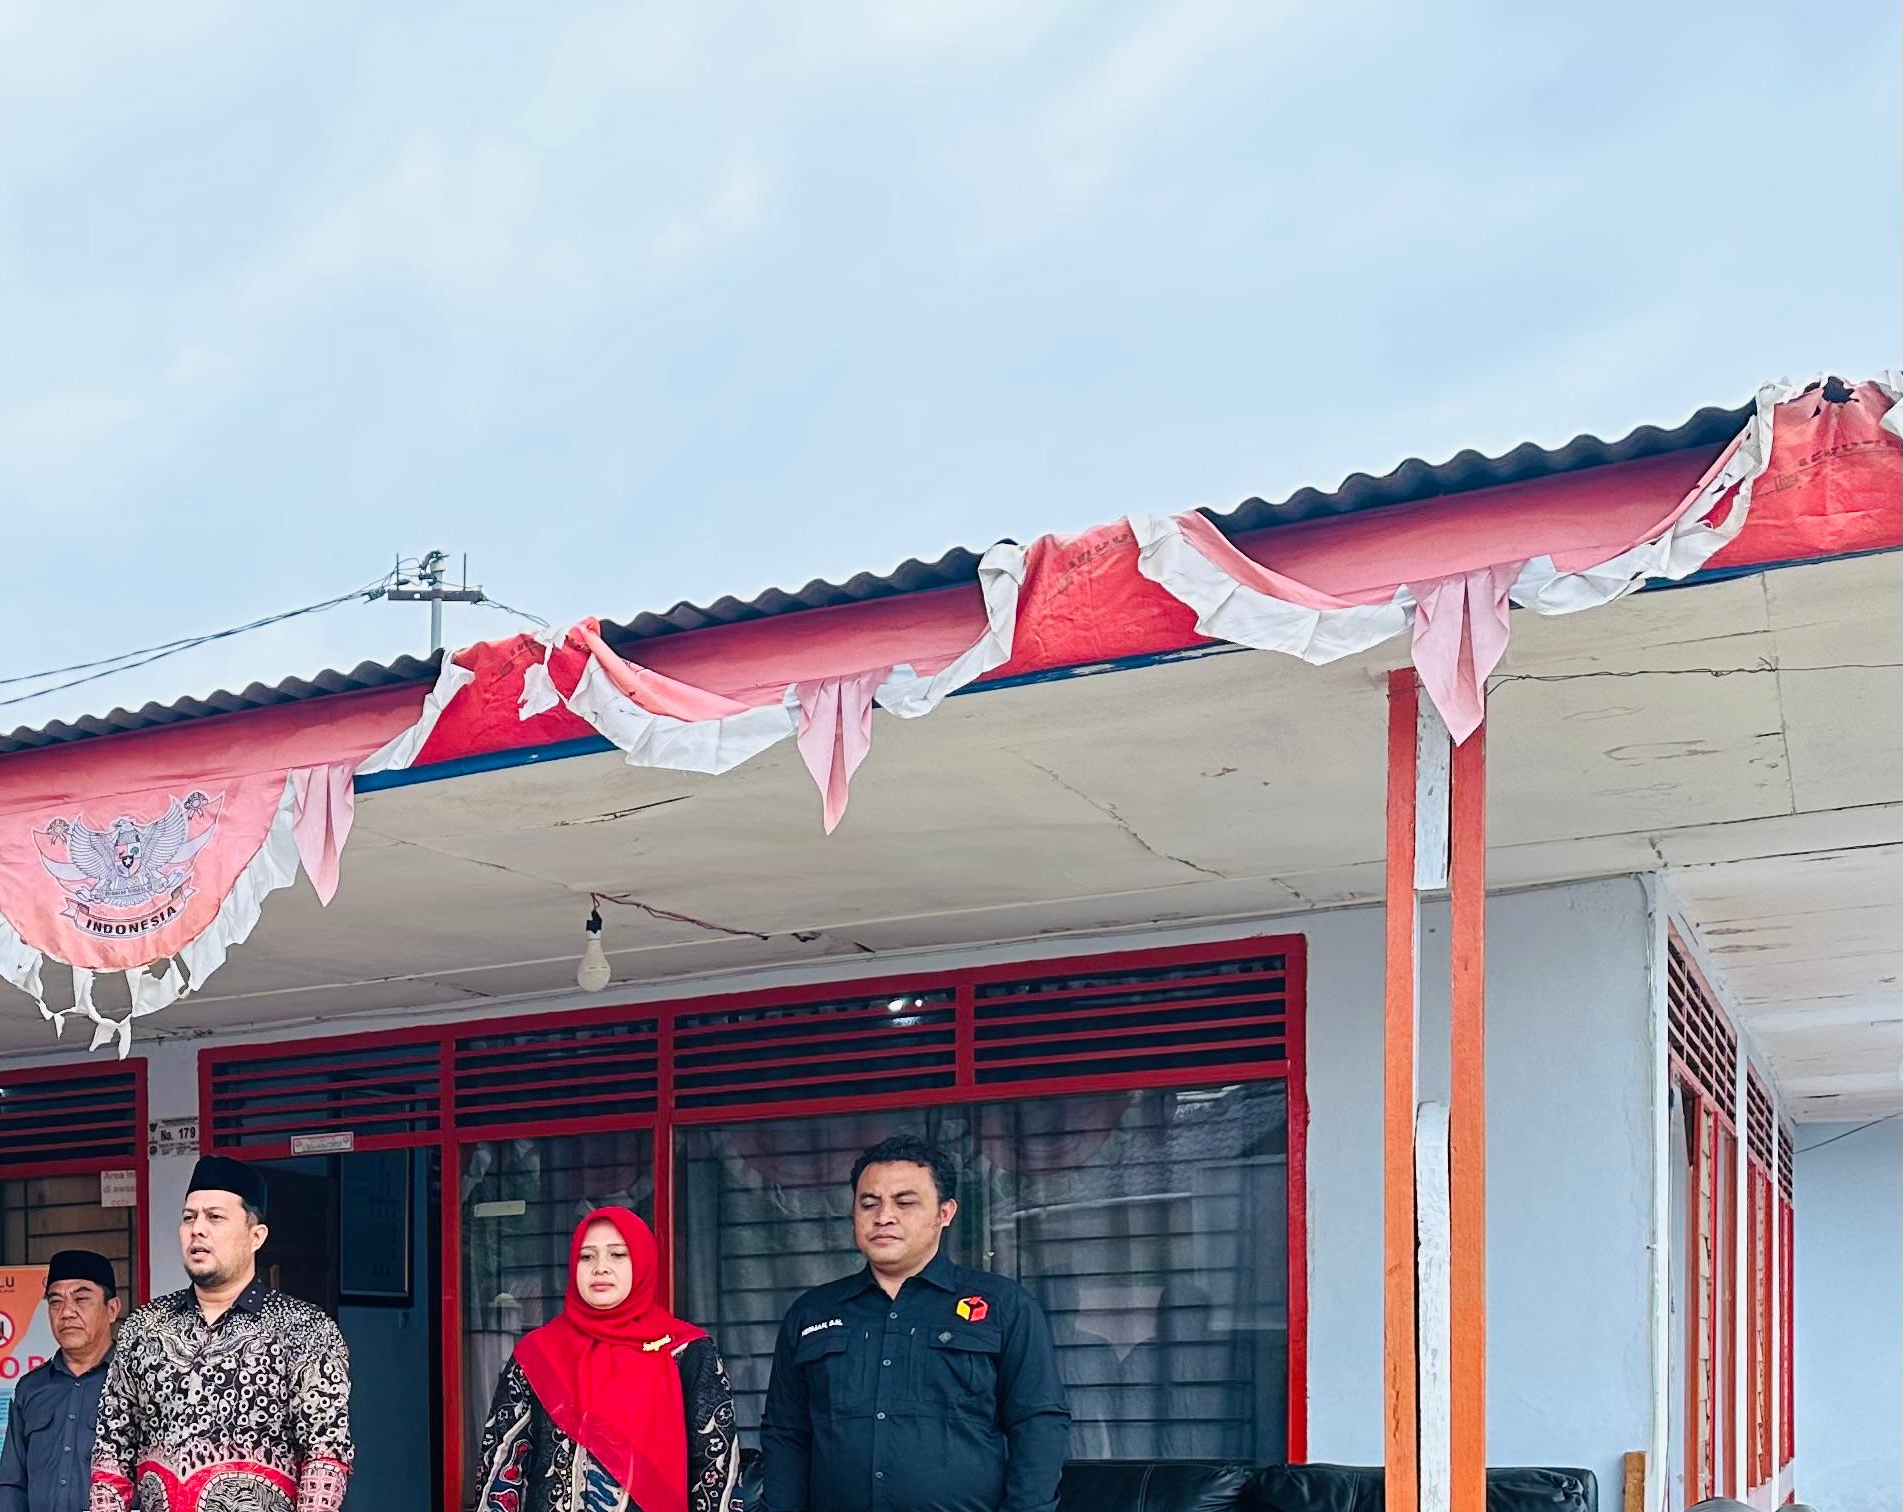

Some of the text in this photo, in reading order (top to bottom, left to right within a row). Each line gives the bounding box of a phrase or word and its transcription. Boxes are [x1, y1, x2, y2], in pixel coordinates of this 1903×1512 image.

[85, 905, 177, 935] INDONESIA
[160, 1126, 196, 1141] No. 179
